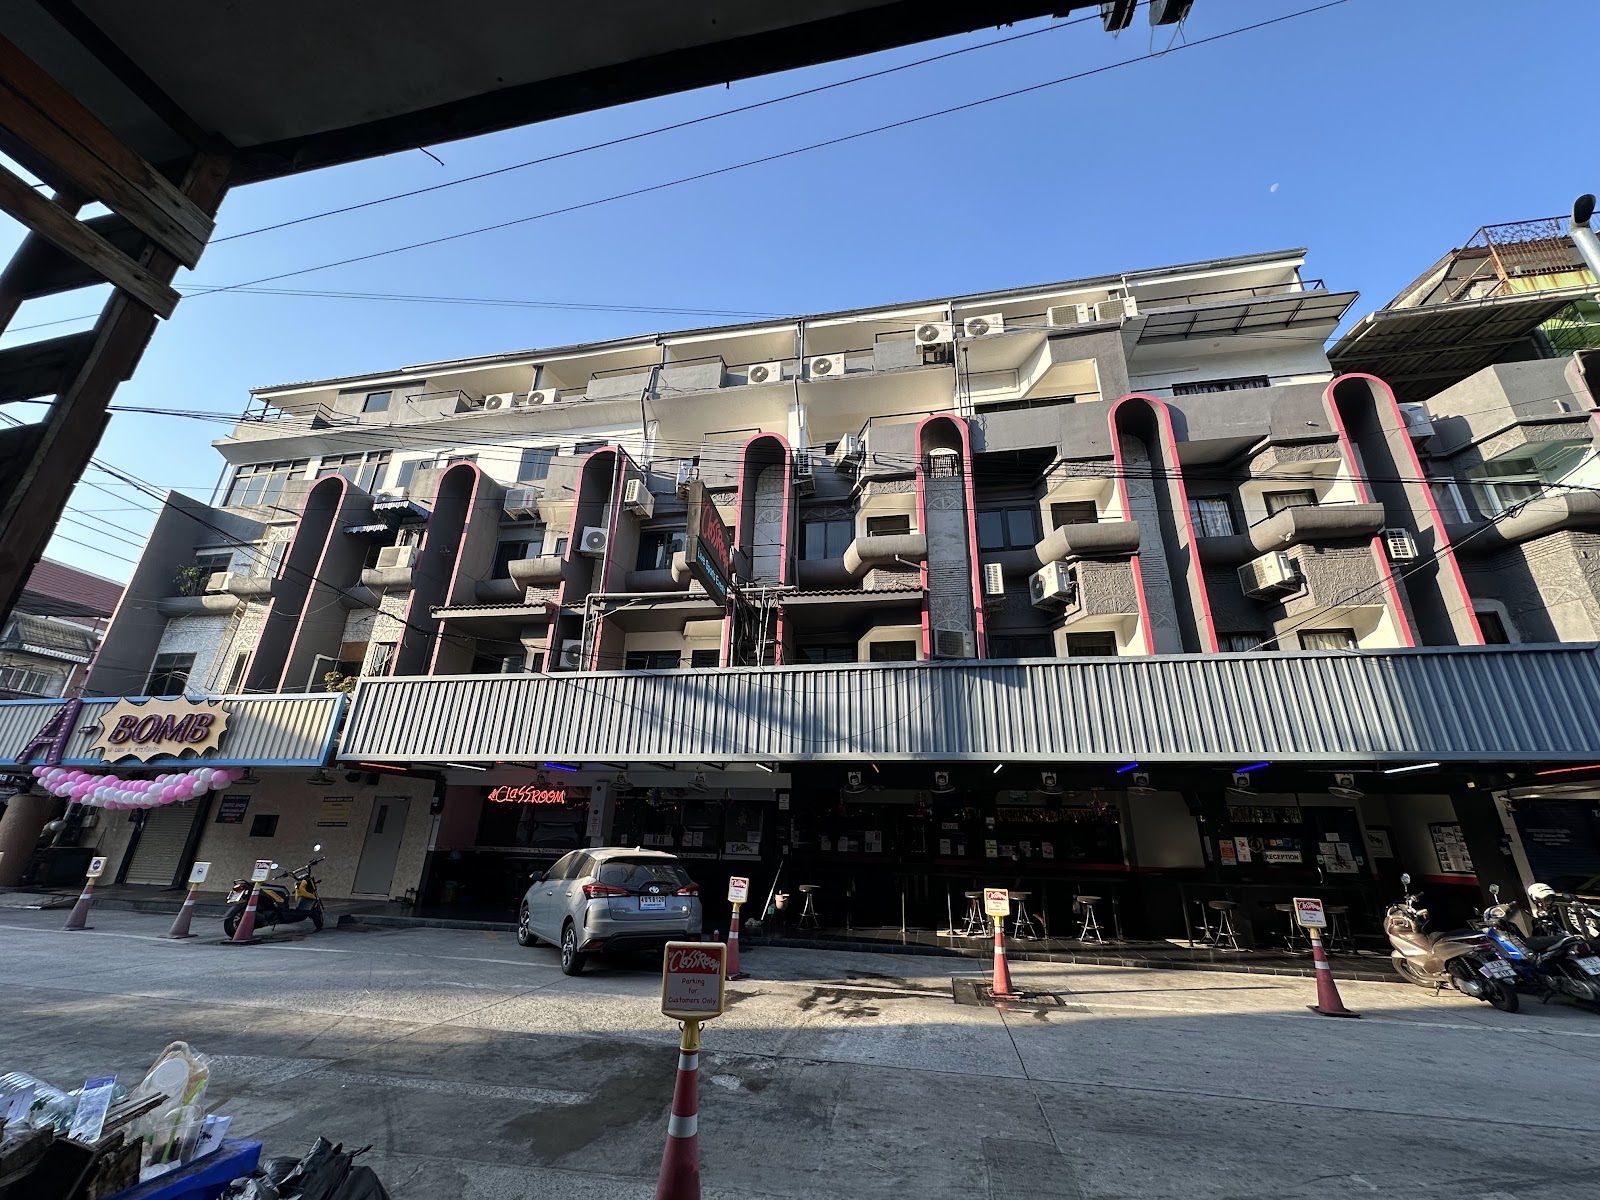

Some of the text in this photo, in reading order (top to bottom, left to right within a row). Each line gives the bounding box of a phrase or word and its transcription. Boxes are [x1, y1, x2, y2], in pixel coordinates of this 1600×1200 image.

[107, 714, 216, 744] BOMB
[682, 978, 705, 986] Parking
[668, 996, 716, 1005] Customers Only
